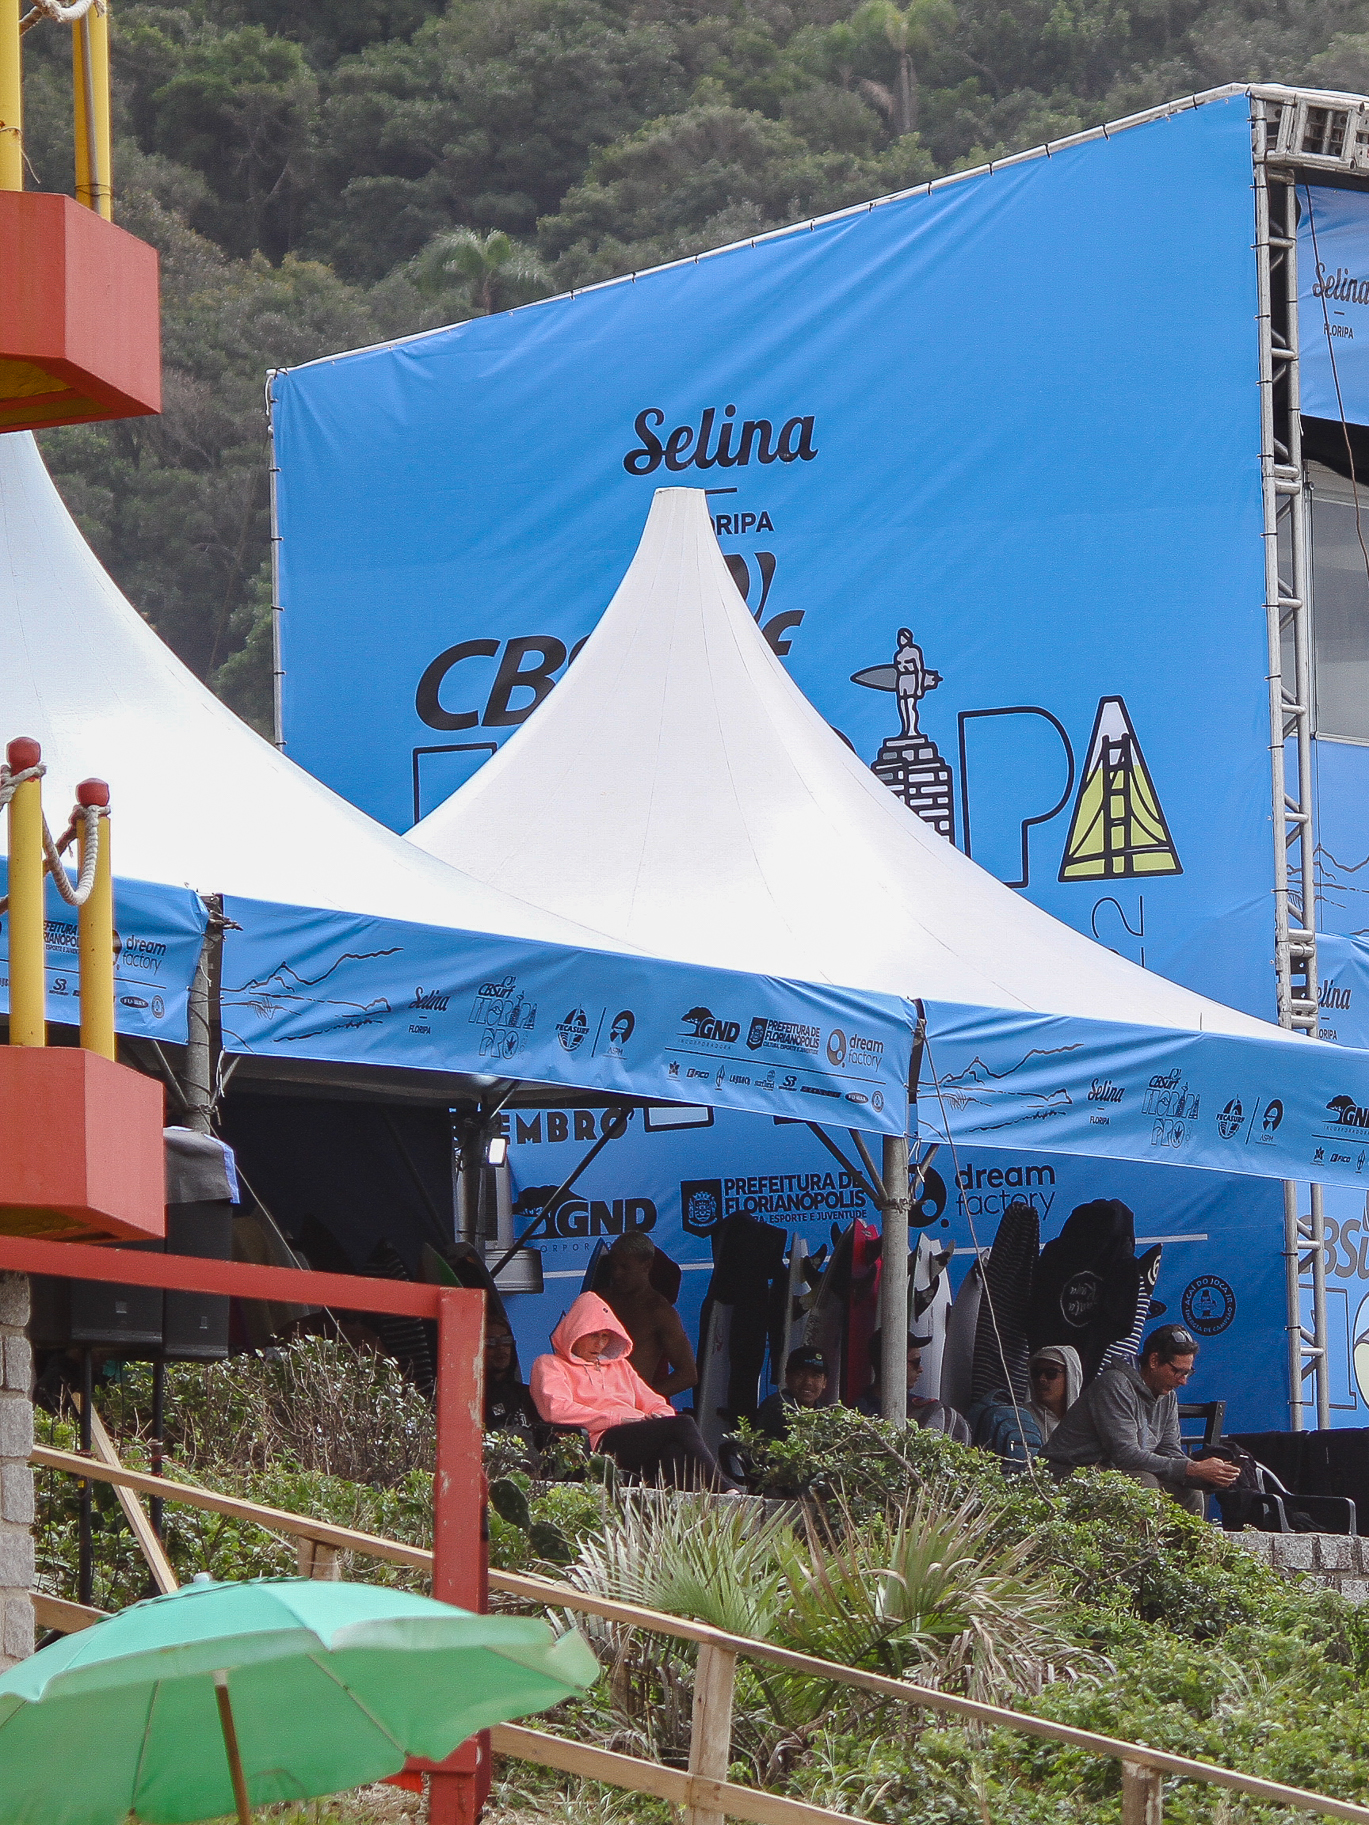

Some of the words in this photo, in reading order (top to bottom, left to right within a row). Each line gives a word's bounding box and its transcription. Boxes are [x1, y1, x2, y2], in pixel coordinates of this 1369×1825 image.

[1324, 323, 1354, 339] FLORIPA
[623, 404, 818, 475] Selina
[710, 511, 774, 535] RIPA
[126, 935, 166, 956] dream
[123, 950, 162, 976] factory
[408, 986, 450, 1012] Selina
[478, 983, 516, 999] CBSurf
[1318, 979, 1351, 1010] elina
[555, 1023, 590, 1035] FECASURF
[700, 1018, 740, 1042] GND
[767, 1019, 810, 1036] PREFEITURA
[811, 1027, 820, 1037] DE
[1318, 1028, 1338, 1040] ORIPA
[850, 1034, 884, 1053] dream
[848, 1050, 882, 1072] factory
[1088, 1077, 1125, 1102] Selina
[498, 1107, 629, 1146] EMBRO
[724, 1172, 837, 1197] PREFEITURA
[954, 1163, 1055, 1190] dream
[724, 1187, 867, 1215] FLORIANÓPOLIS
[556, 1200, 657, 1237] GND
[768, 1213, 808, 1224] ESPORTE
[810, 1213, 816, 1221] E
[817, 1210, 867, 1221] JUVENTUDE
